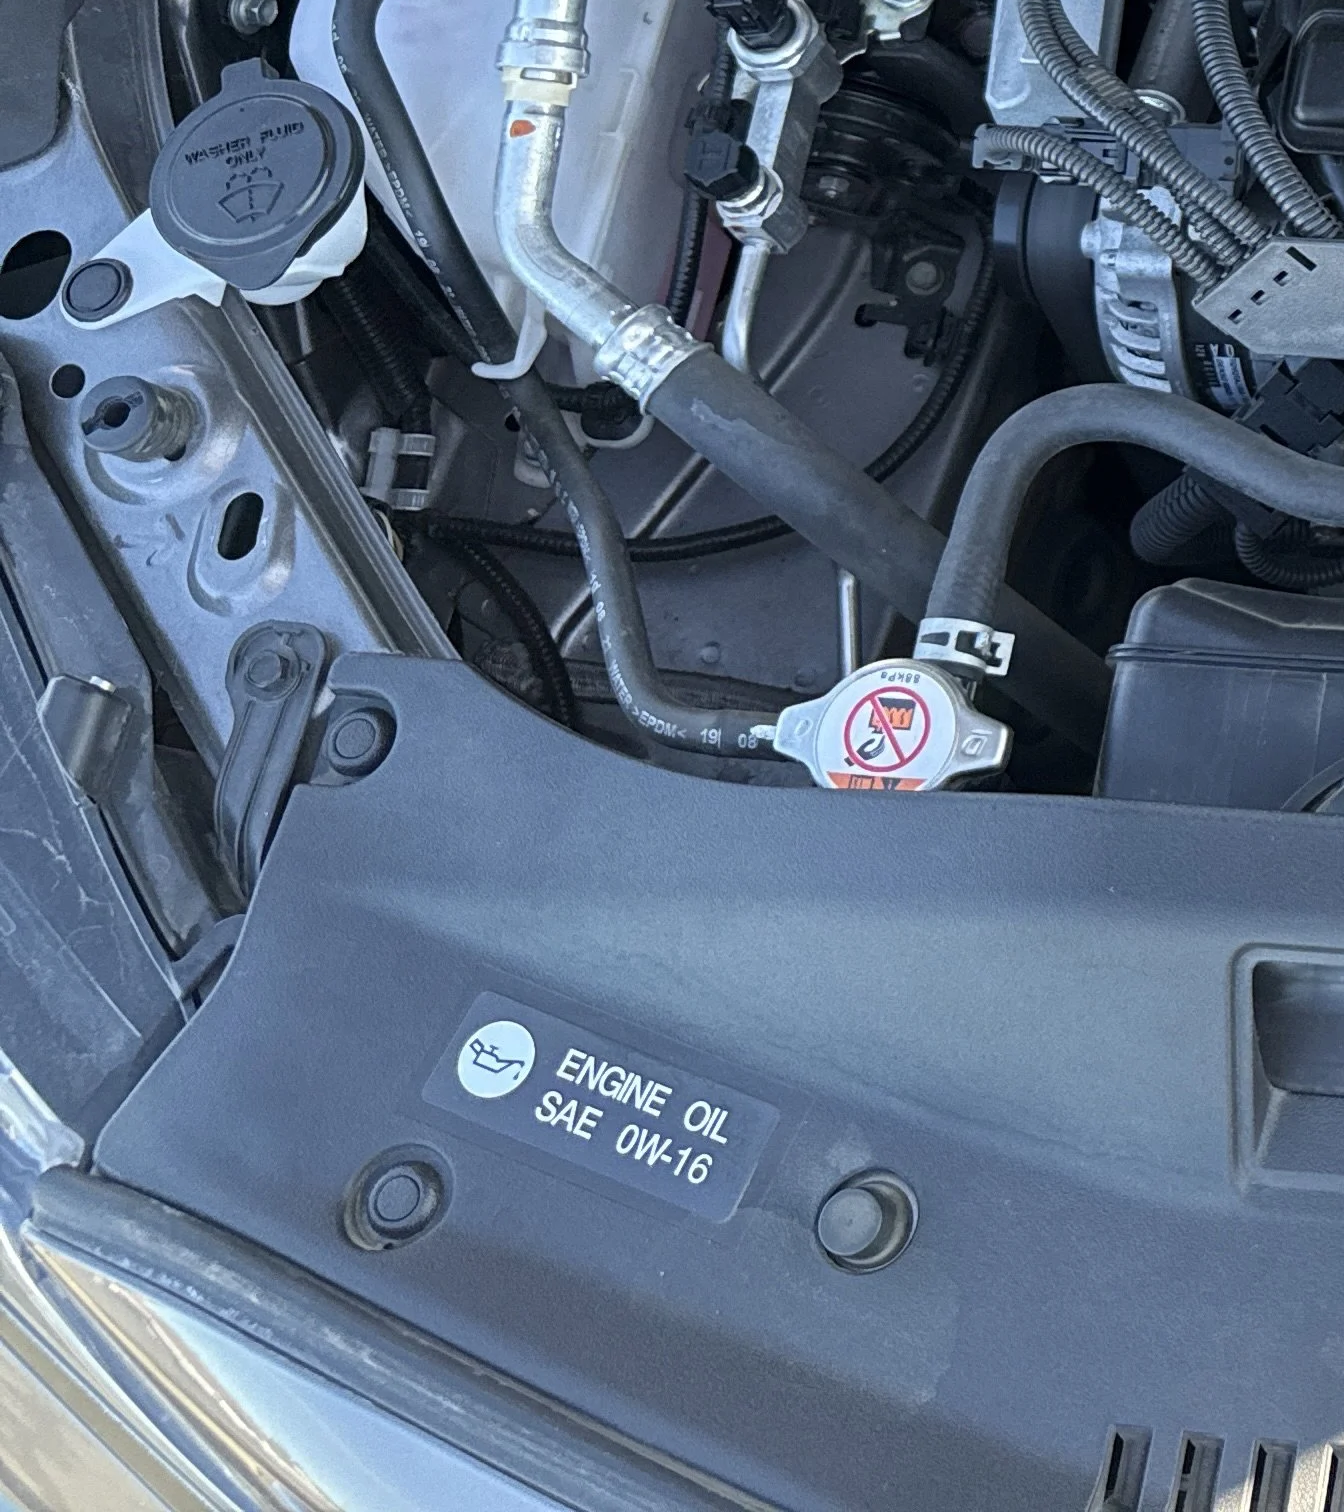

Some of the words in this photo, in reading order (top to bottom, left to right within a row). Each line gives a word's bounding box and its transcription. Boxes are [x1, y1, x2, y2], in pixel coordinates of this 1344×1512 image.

[184, 136, 251, 166] WASHER
[260, 122, 304, 145] FLUID
[225, 148, 267, 167] ONLY
[880, 671, 921, 684] 88kPa
[556, 1047, 673, 1117] ENGINE
[683, 1100, 729, 1145] OIL
[535, 1090, 604, 1140] SAE
[615, 1124, 713, 1184] 0W-16
